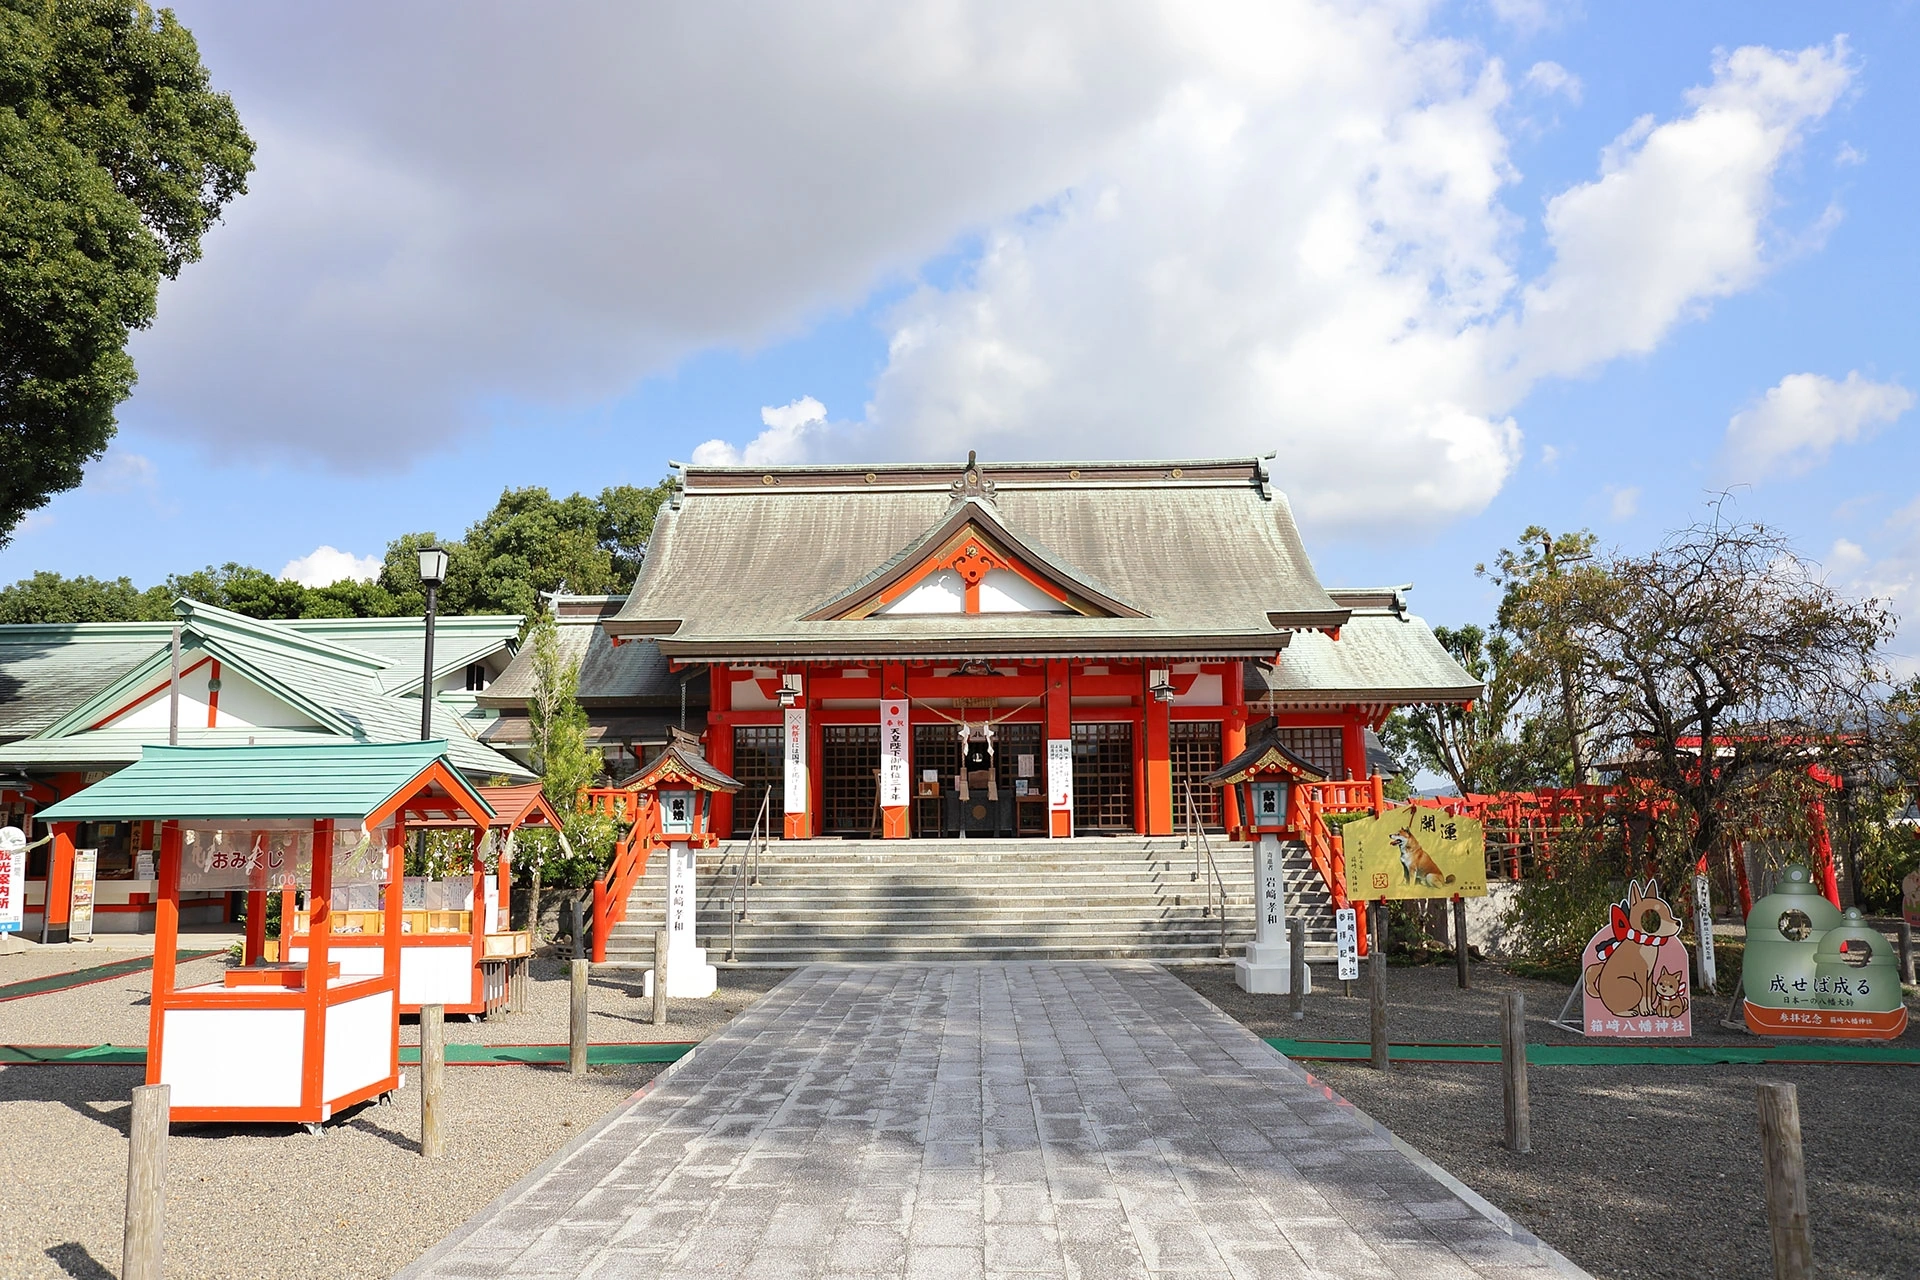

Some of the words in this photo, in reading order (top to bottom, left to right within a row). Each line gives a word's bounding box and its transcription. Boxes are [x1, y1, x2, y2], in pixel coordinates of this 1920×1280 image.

[890, 727, 902, 801] 天皇陛下御即位三十年
[1420, 815, 1457, 841] 開運
[213, 851, 284, 870] おみくじ
[1768, 974, 1870, 996] 成せば成る
[1783, 996, 1854, 1007] 日本一の八幡大鈴
